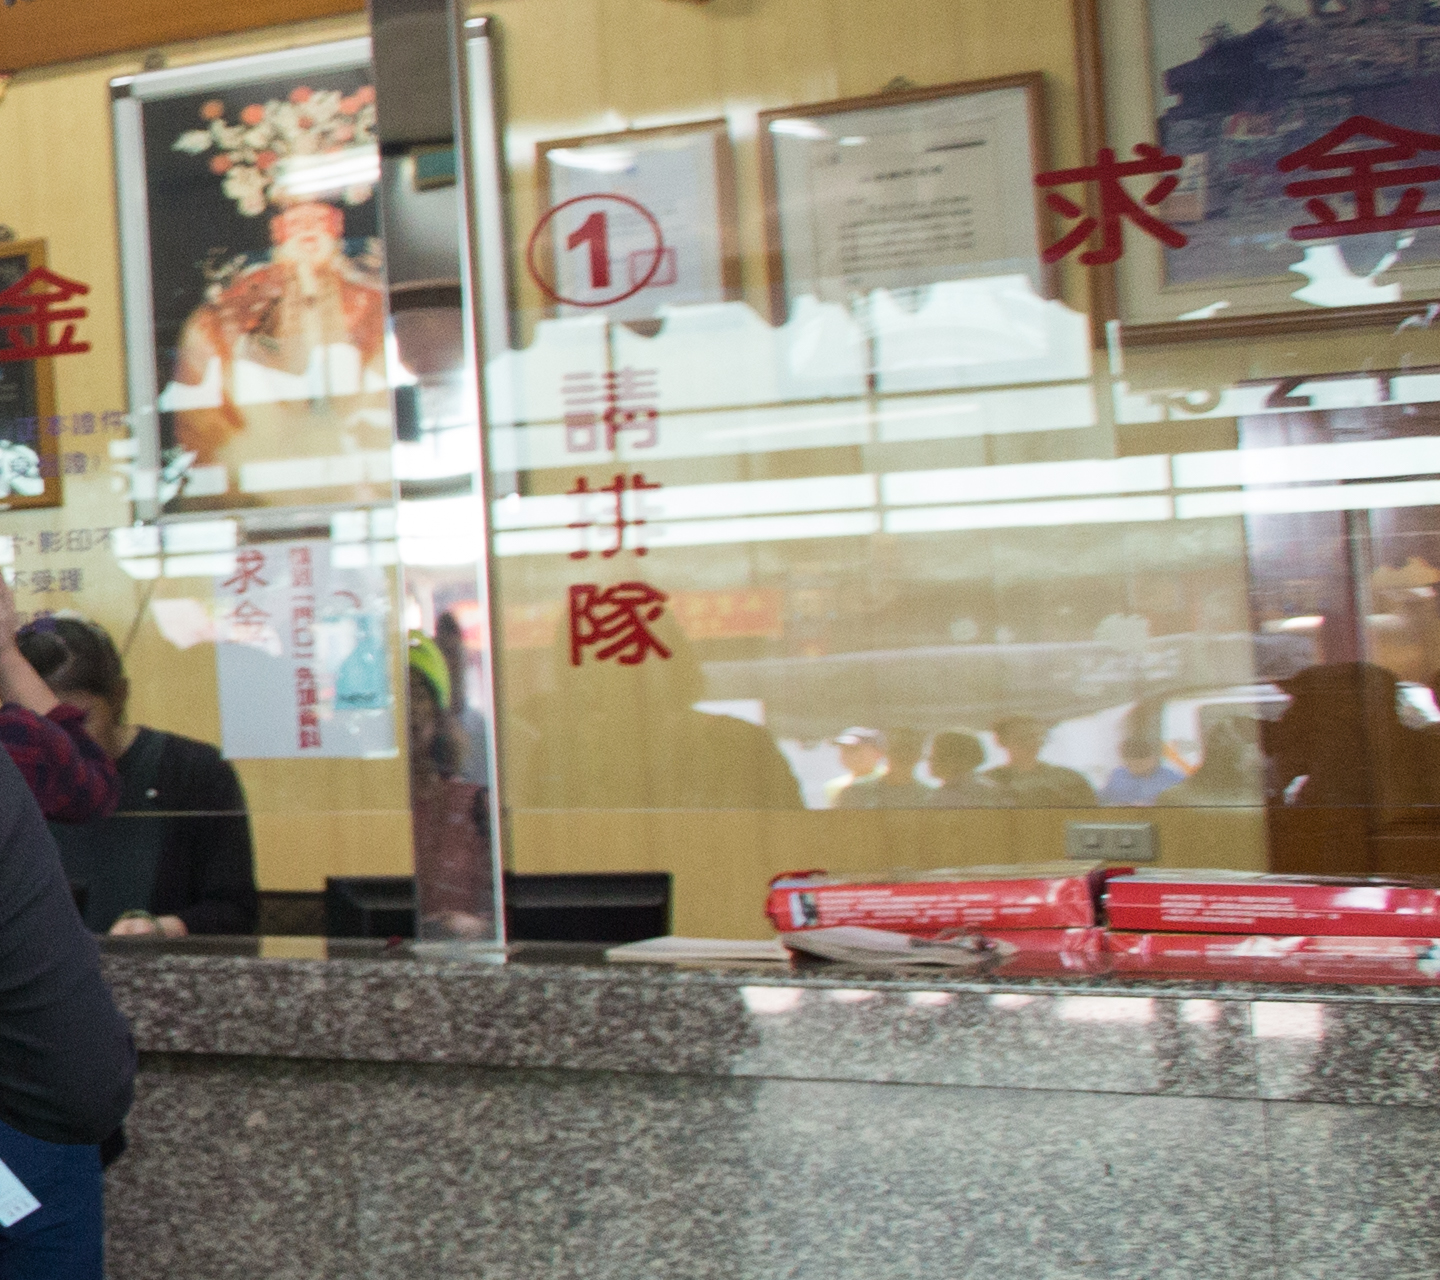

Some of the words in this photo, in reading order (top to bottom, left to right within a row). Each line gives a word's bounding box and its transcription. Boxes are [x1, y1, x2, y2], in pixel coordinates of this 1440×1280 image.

[1034, 115, 1440, 266] 求金
[560, 365, 672, 666] 請排隊
